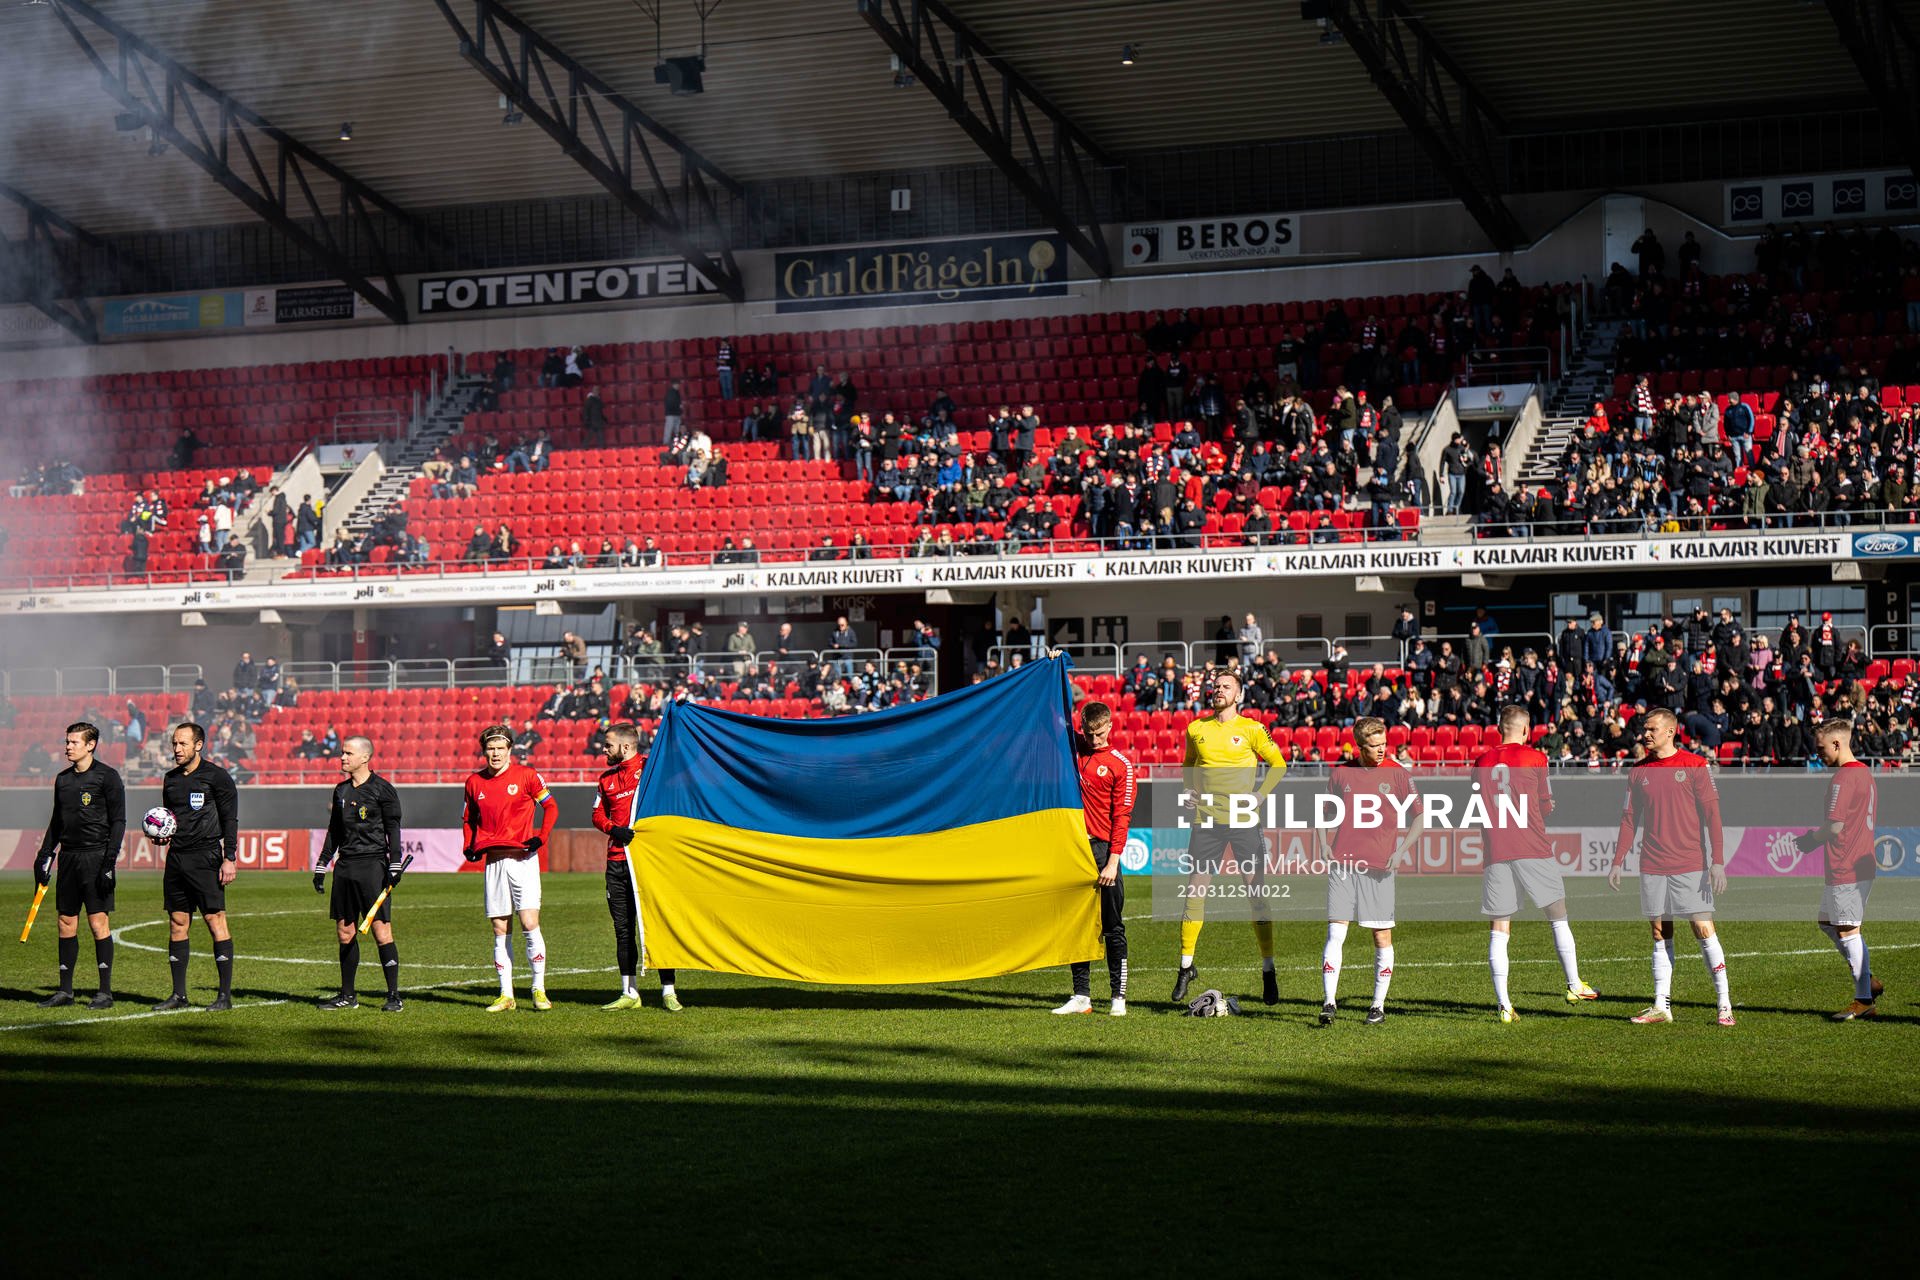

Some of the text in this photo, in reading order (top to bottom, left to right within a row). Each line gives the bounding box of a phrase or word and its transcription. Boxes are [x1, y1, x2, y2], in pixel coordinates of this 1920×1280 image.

[1177, 218, 1292, 251] BEROS
[784, 246, 1024, 300] GuldFågeln
[278, 304, 352, 319] ALARMSTREET
[1670, 538, 1840, 559] KALMAR KUVERT
[1864, 537, 1898, 551] Ford
[1286, 552, 1441, 570] KALMAR KUVERT
[1473, 544, 1637, 565] KALMAR KUVERT
[932, 563, 1076, 581] KALMAR KUVERT
[1106, 557, 1255, 576] KALMAR KUVERT
[722, 573, 745, 588] joli
[767, 569, 904, 586] KALMAR KUVERT
[354, 585, 374, 600] joli
[533, 579, 555, 594] joli
[17, 597, 36, 610] joli
[181, 591, 201, 605] joli
[832, 596, 876, 610] KIOSK
[1887, 592, 1898, 642] PUB
[1589, 858, 1632, 872] SPL
